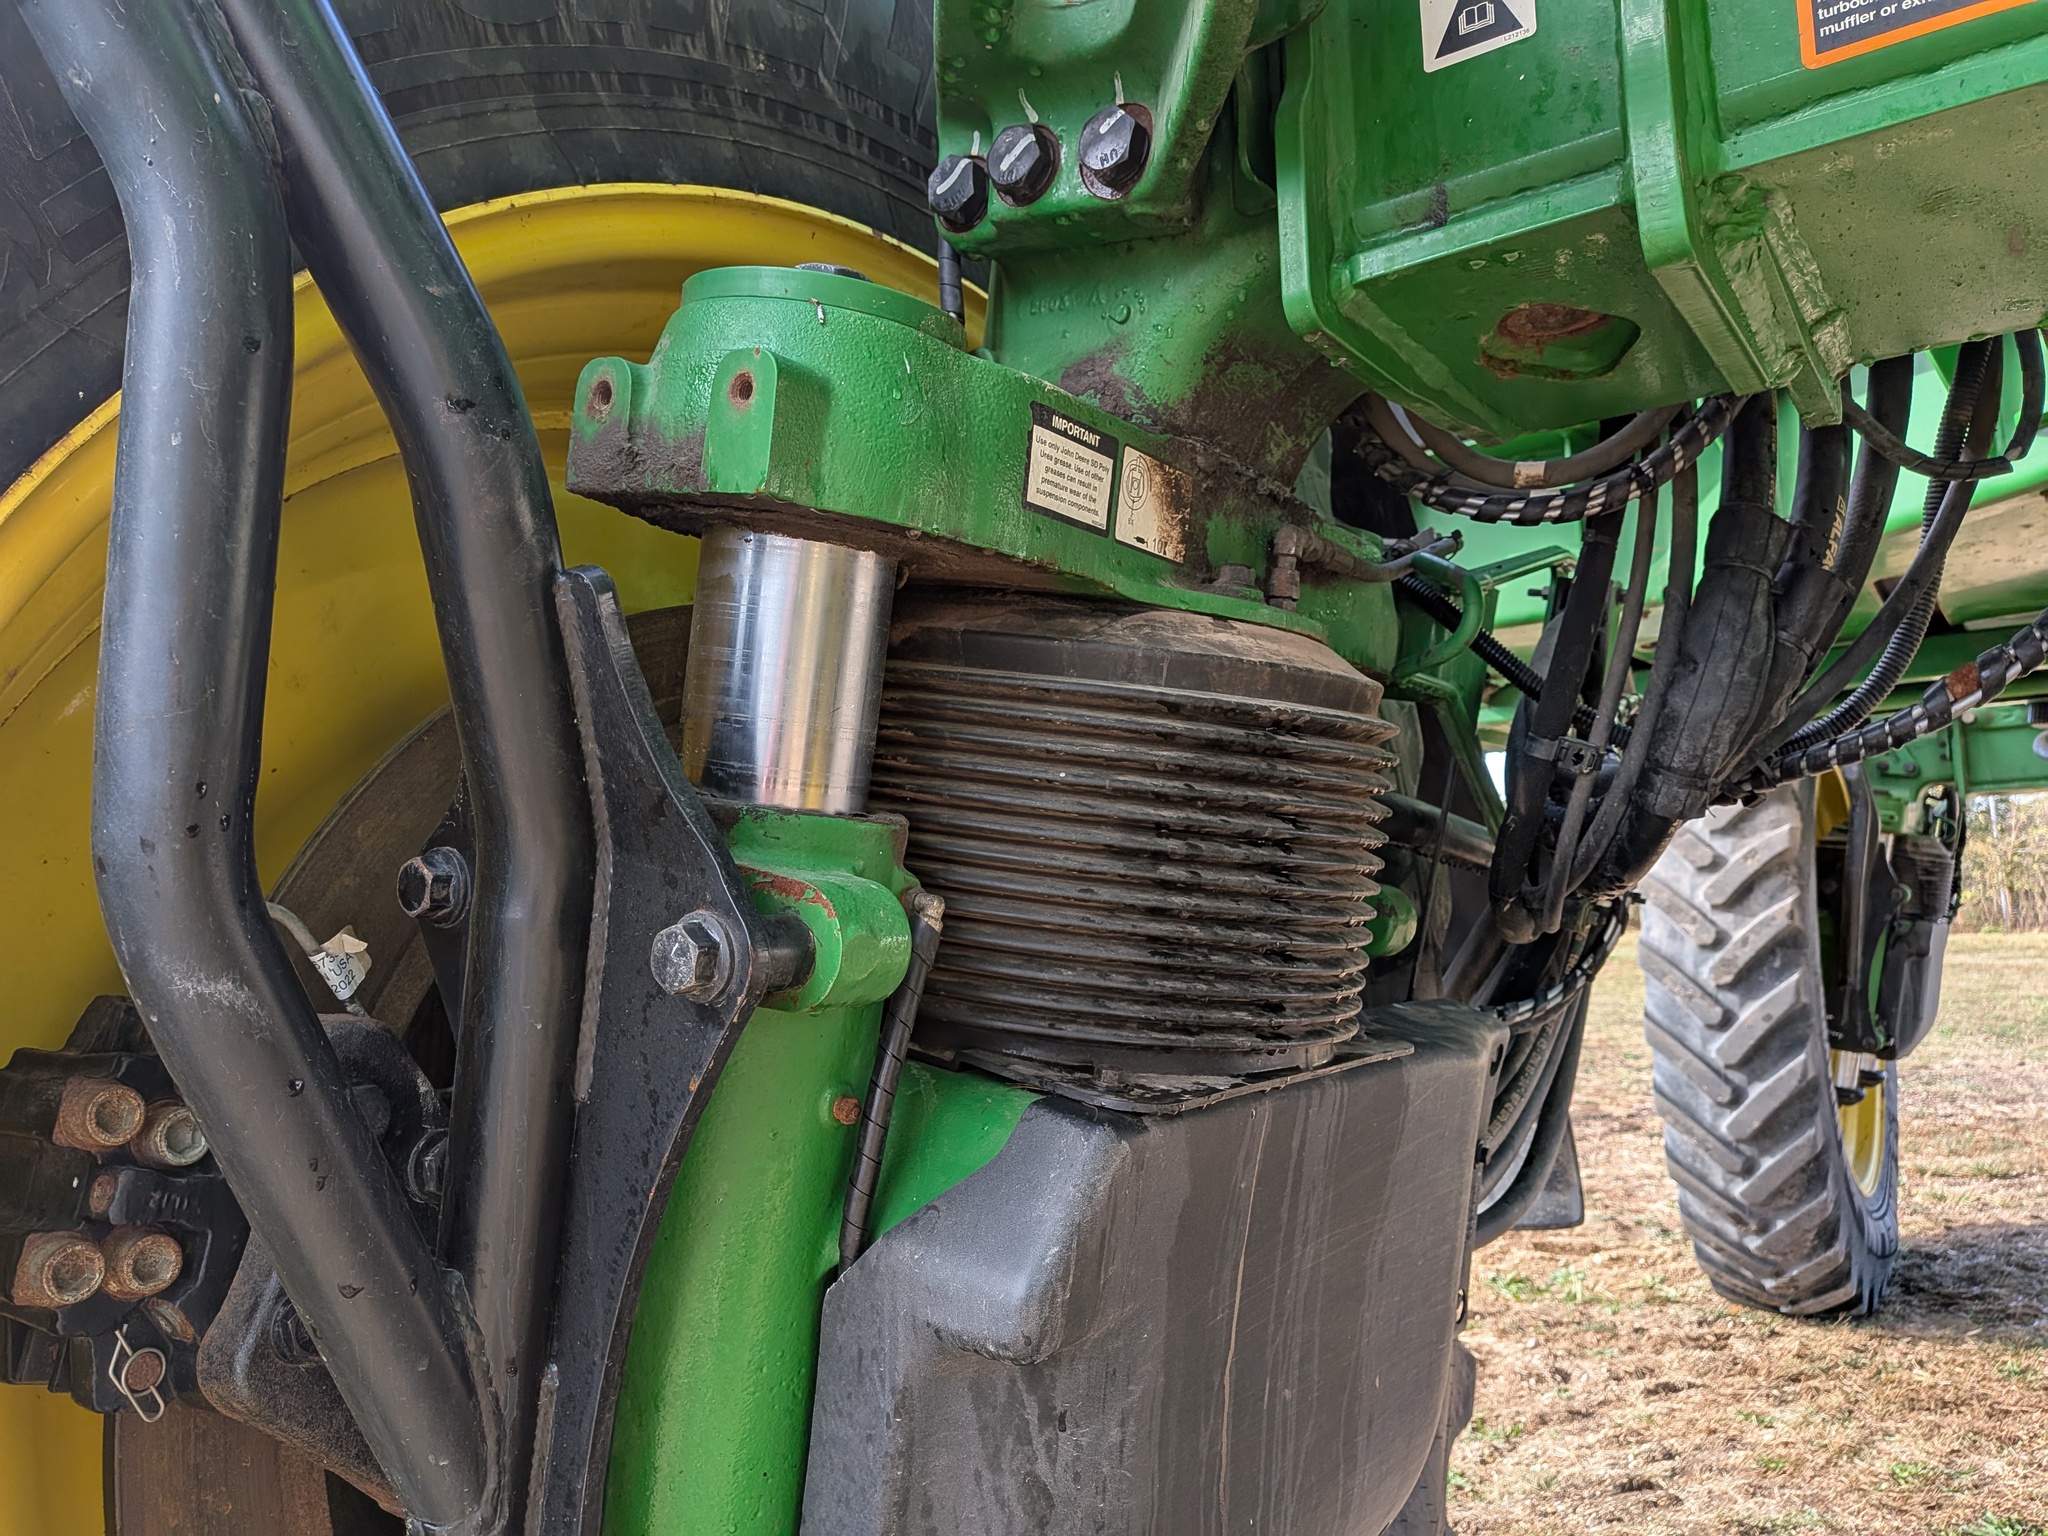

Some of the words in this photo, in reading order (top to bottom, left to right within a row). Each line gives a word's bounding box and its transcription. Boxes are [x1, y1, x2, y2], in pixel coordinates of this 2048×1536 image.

[1819, 10, 1877, 37] muffler
[1880, 3, 1899, 17] or
[1052, 415, 1101, 447] IMPORTANT
[1036, 434, 1047, 446] Use
[1048, 441, 1060, 453] only
[1060, 446, 1074, 460] John
[1075, 451, 1090, 465] Deere
[1090, 458, 1099, 469] SD
[1099, 462, 1110, 475] Poly
[1040, 449, 1053, 461] Urea
[1054, 457, 1073, 470] grease.
[1074, 463, 1084, 474] Use
[1084, 469, 1091, 478] of
[1091, 471, 1104, 483] other
[1040, 476, 1069, 493] premature
[1069, 487, 1082, 498] wear
[1082, 492, 1089, 500] of
[1089, 494, 1097, 504] the
[1044, 465, 1066, 480] greases
[1066, 474, 1077, 483] can
[1077, 479, 1092, 490] result
[1092, 483, 1098, 492] in
[1035, 487, 1067, 504] suspension
[1067, 499, 1100, 517] components.
[331, 969, 356, 994] 2022
